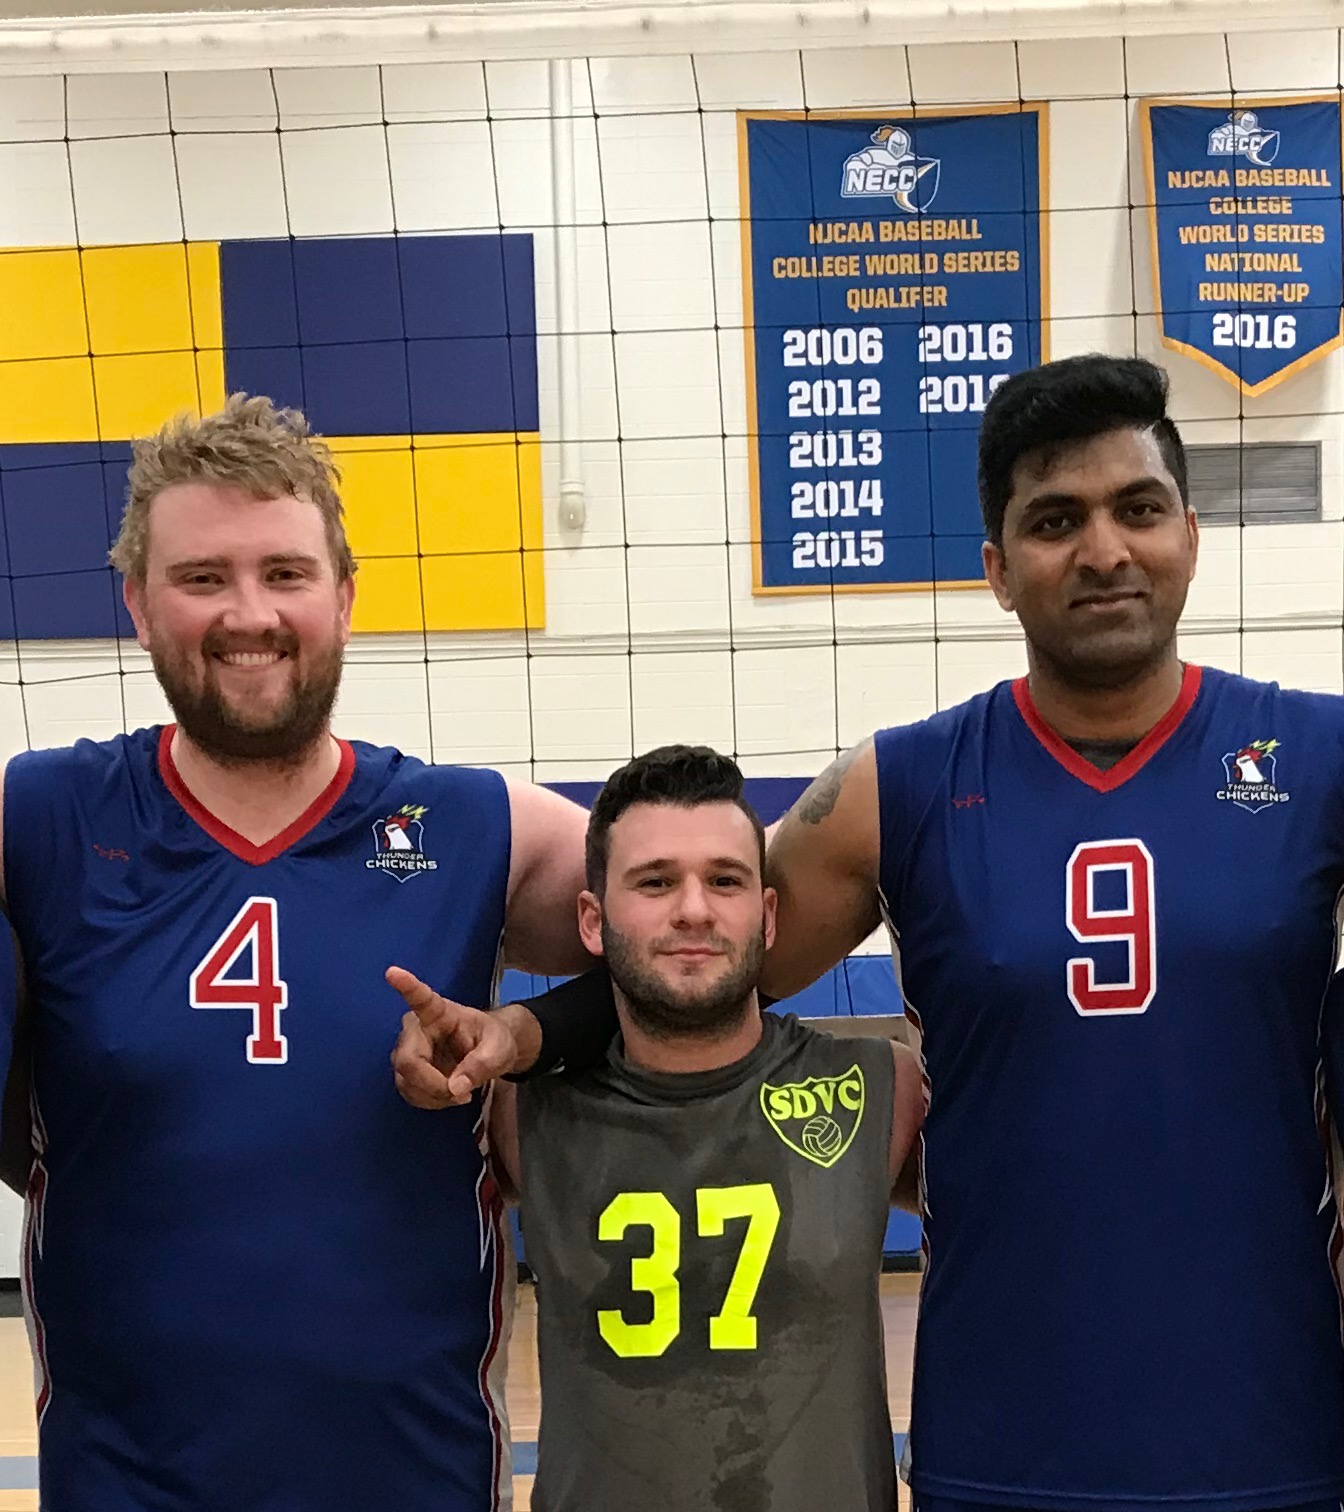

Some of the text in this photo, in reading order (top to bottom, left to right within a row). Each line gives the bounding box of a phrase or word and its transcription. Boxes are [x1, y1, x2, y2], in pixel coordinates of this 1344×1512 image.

[1211, 136, 1262, 152] NECC
[846, 166, 917, 192] NECC
[1167, 168, 1332, 189] NJCAA BASEBALL
[1209, 196, 1293, 215] COLLEGE
[809, 218, 983, 245] NJCAA BASEBALL
[1178, 223, 1325, 244] WORLD SERIES
[772, 249, 1020, 280] COLLEGE WORLD SERIES
[1205, 252, 1303, 273] NATIONAL
[846, 285, 948, 313] QUALIFER
[1198, 282, 1310, 303] RUNNER-UP
[1212, 312, 1297, 349] 2016
[782, 321, 1014, 368] 2006 2016
[788, 377, 882, 418] 2012
[788, 429, 883, 469] 2013
[791, 479, 884, 519] 2014
[792, 528, 884, 569] 2015
[1216, 790, 1290, 802] CHICKENS
[1227, 783, 1276, 792] THUNDER
[365, 859, 438, 870] CHICKENS
[376, 852, 424, 860] THUNDER
[1066, 838, 1156, 1017] 9
[189, 896, 288, 1065] 4
[768, 1080, 863, 1121] SDVC
[597, 1183, 781, 1358] 37
